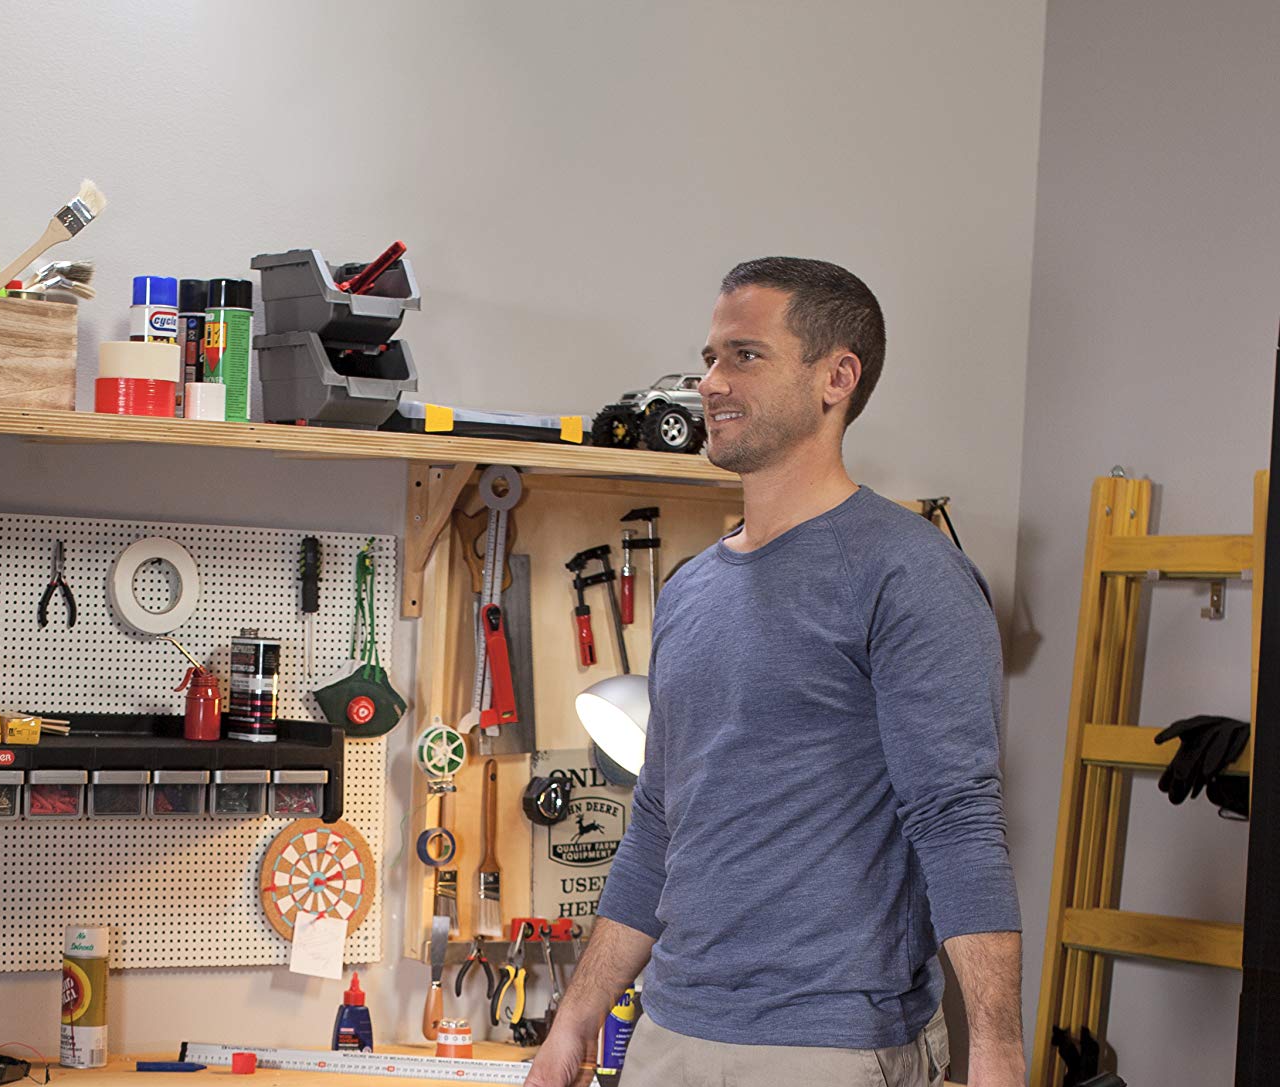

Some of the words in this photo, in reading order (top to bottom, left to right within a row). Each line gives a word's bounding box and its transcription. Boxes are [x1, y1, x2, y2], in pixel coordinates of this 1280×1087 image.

[568, 802, 582, 815] HN
[585, 801, 619, 818] DEERE
[556, 843, 593, 854] QUALITY
[594, 841, 617, 851] FARM
[561, 847, 612, 860] EQUIPMENT
